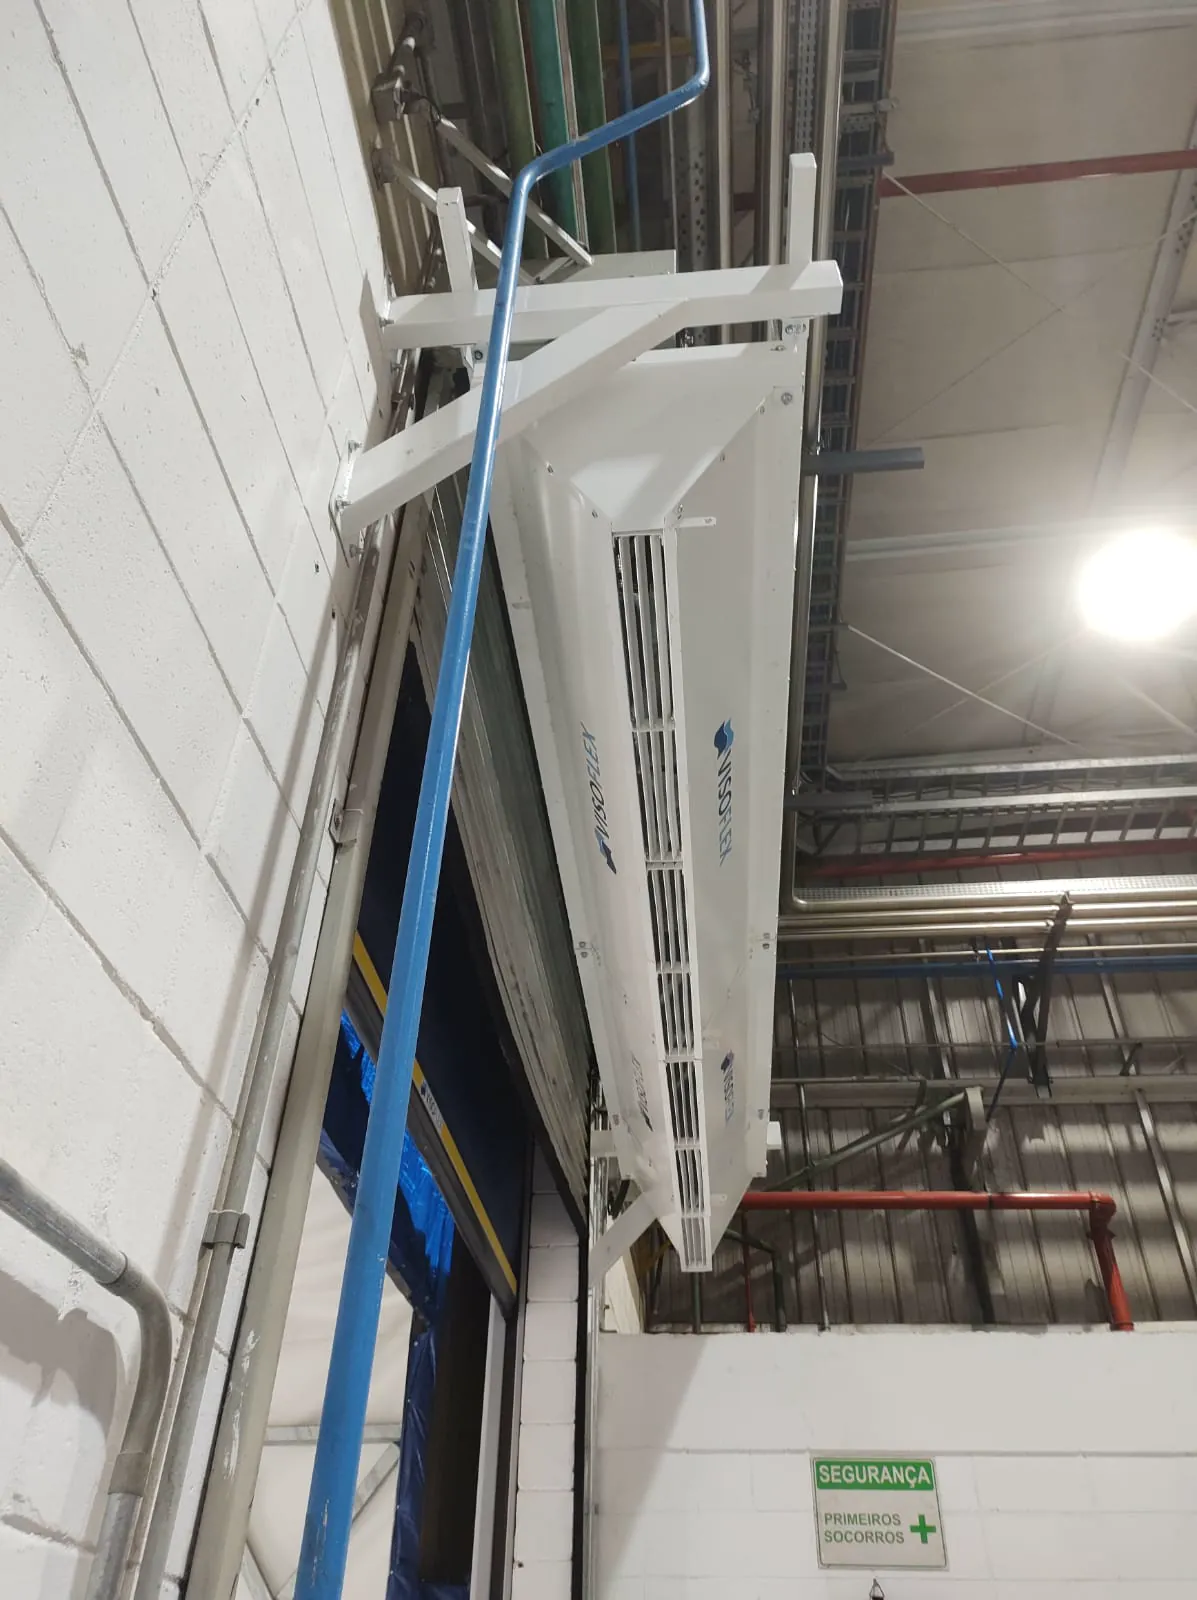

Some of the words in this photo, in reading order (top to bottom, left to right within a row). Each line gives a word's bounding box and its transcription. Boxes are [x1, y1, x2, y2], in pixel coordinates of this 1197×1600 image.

[581, 721, 609, 839] VISOFLEX
[718, 748, 732, 868] VISOFLEX
[819, 1465, 931, 1488] SEGURANÇA
[824, 1512, 902, 1526] PRIMEIROS
[824, 1530, 905, 1544] SOCORROS
